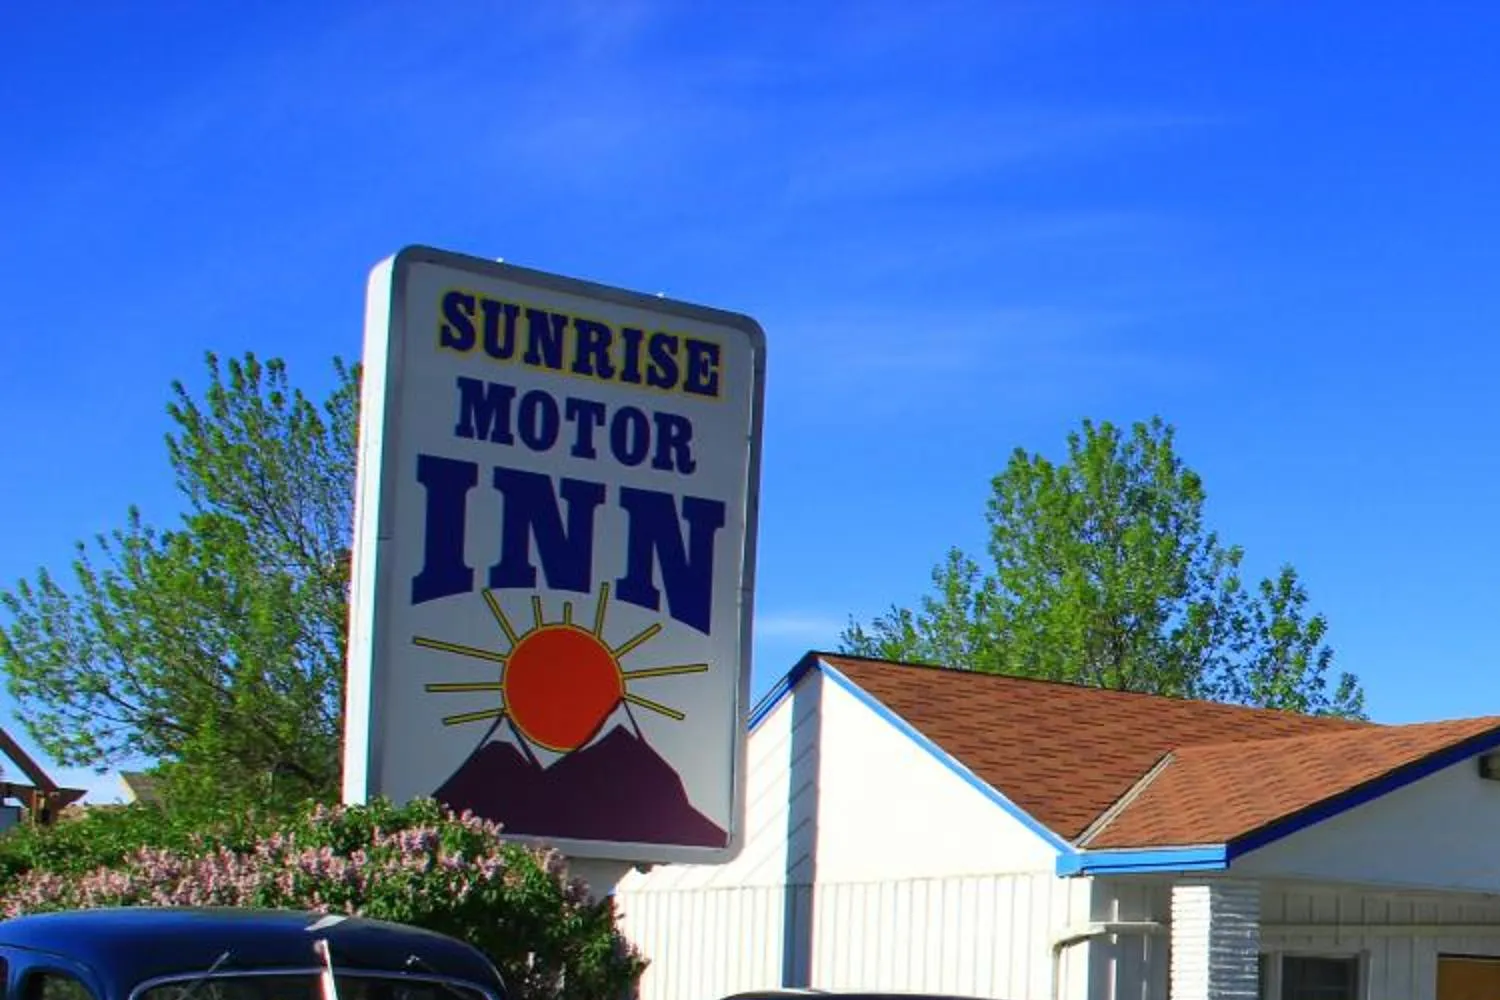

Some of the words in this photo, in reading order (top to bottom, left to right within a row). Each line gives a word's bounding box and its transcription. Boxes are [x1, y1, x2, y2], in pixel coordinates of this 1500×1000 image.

[438, 289, 722, 398] SUNRISE
[453, 375, 698, 476] MOTOR
[411, 452, 727, 637] INN
